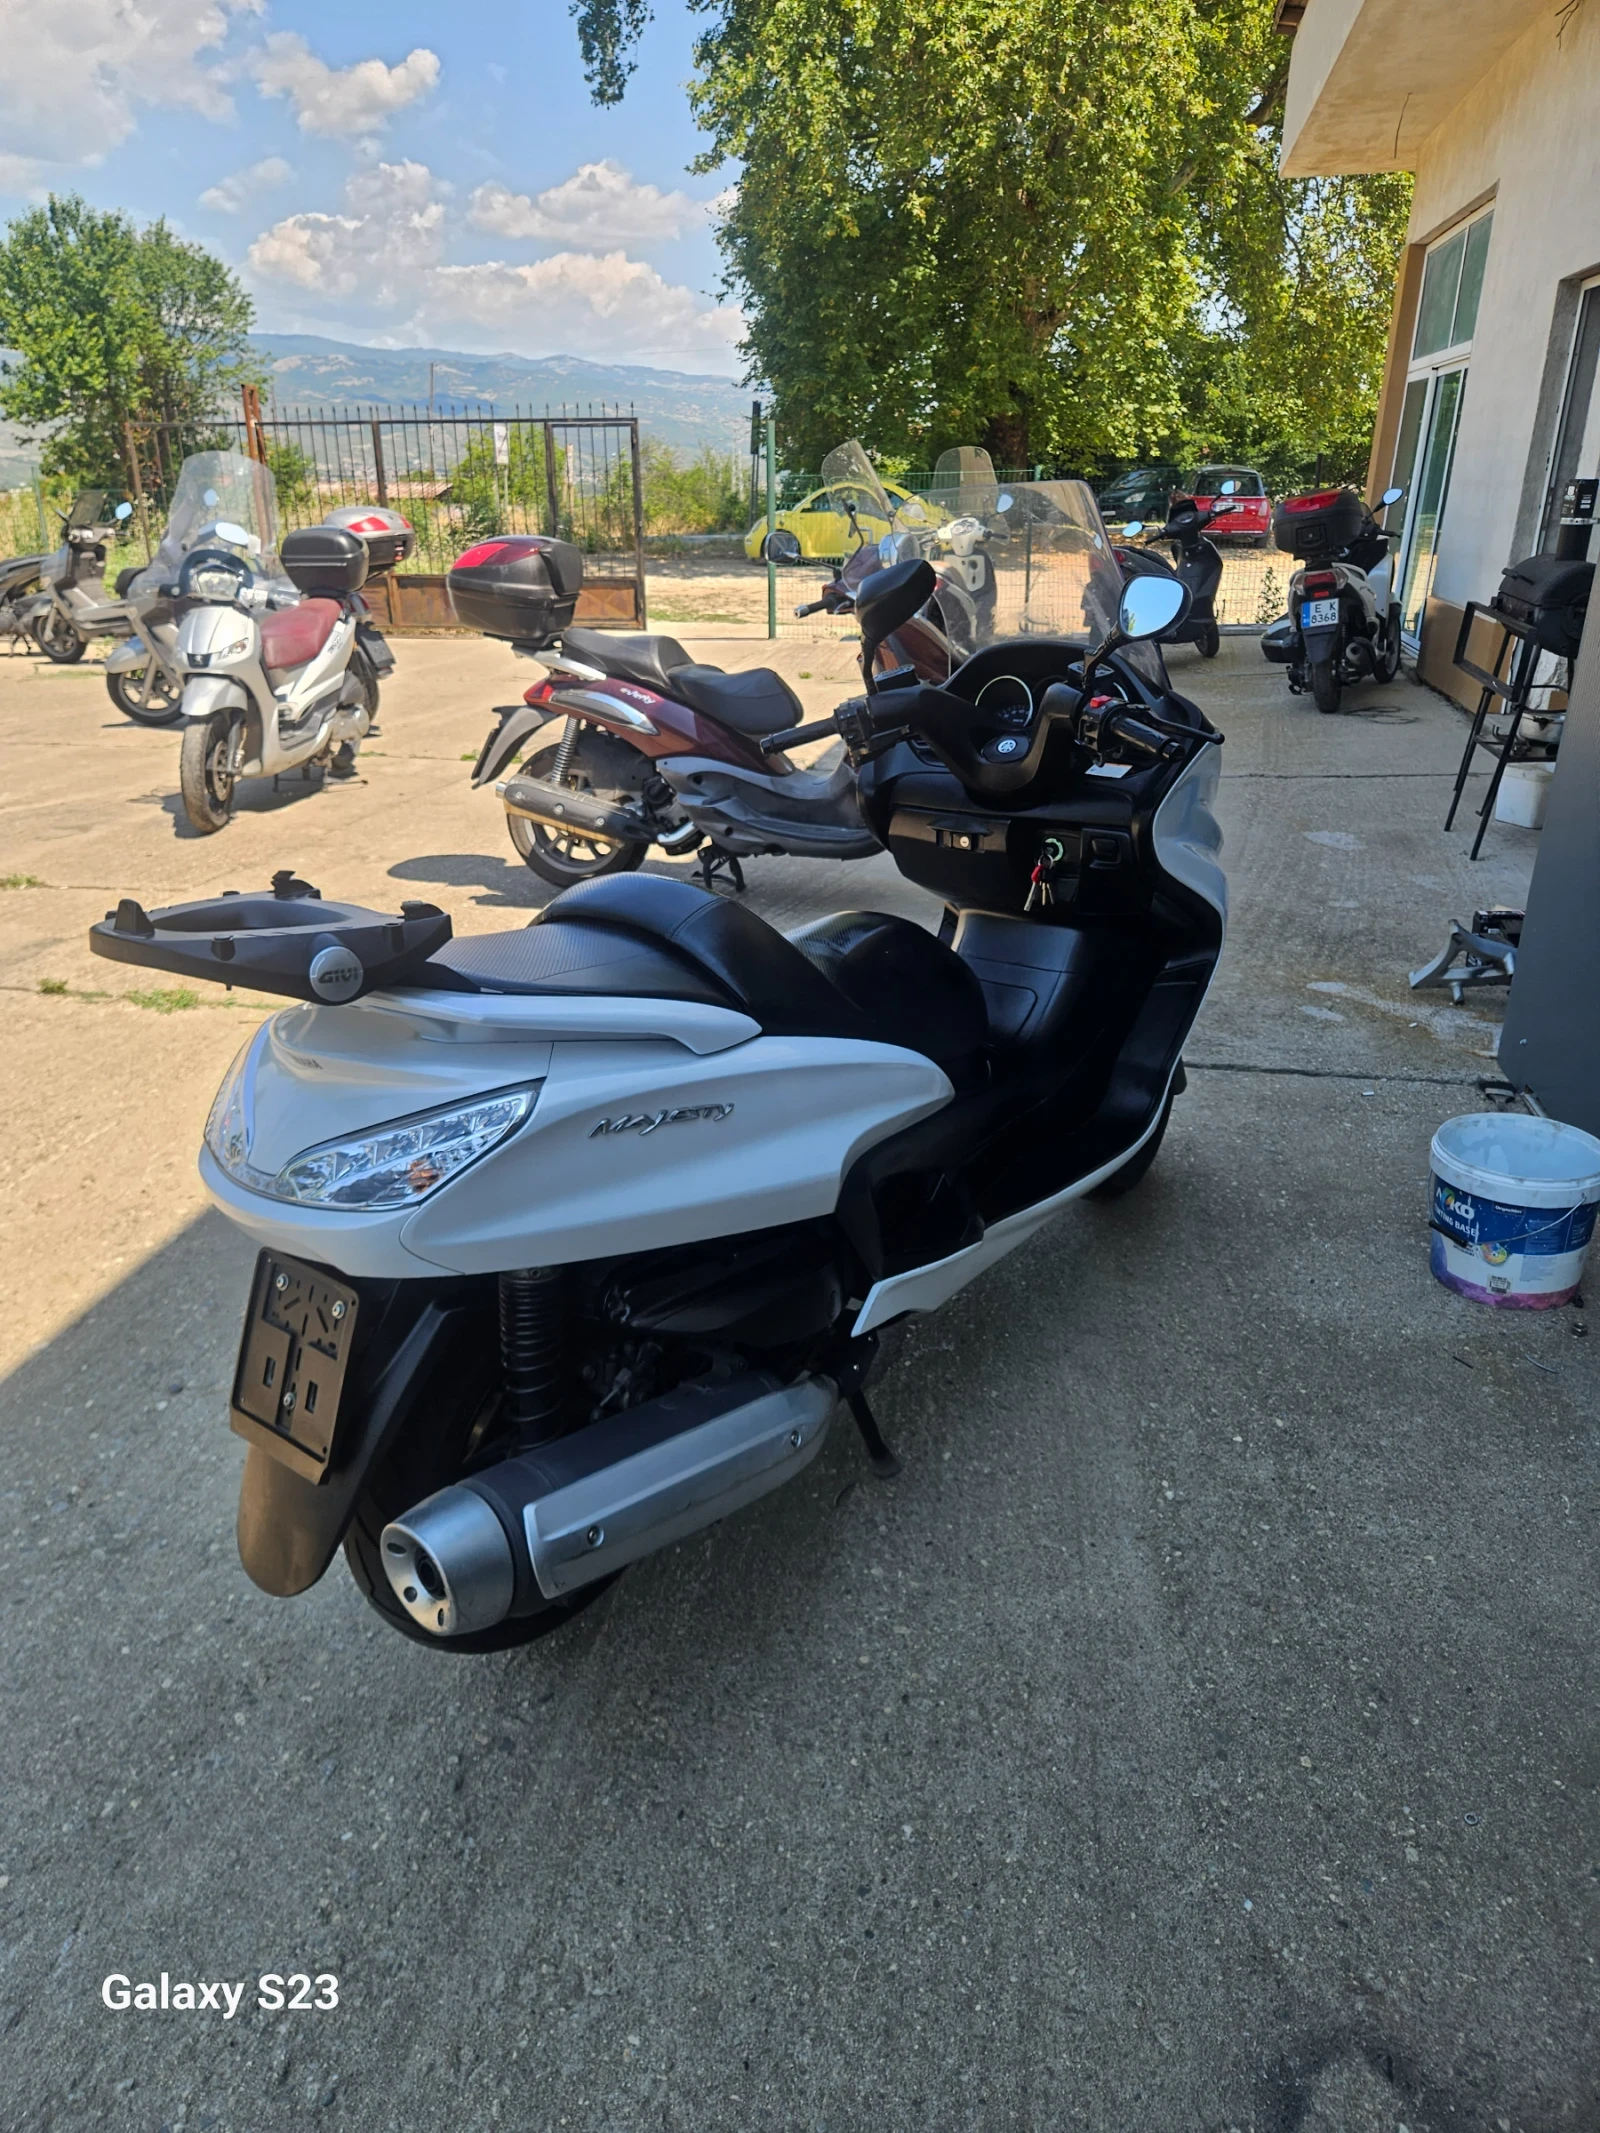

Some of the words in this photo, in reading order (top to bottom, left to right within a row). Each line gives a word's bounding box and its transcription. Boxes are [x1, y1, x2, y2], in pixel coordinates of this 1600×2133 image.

[1315, 604, 1322, 613] E
[1329, 601, 1336, 611] K
[1311, 612, 1337, 624] 8368
[318, 966, 359, 984] GIVI
[1455, 1221, 1479, 1237] BASE
